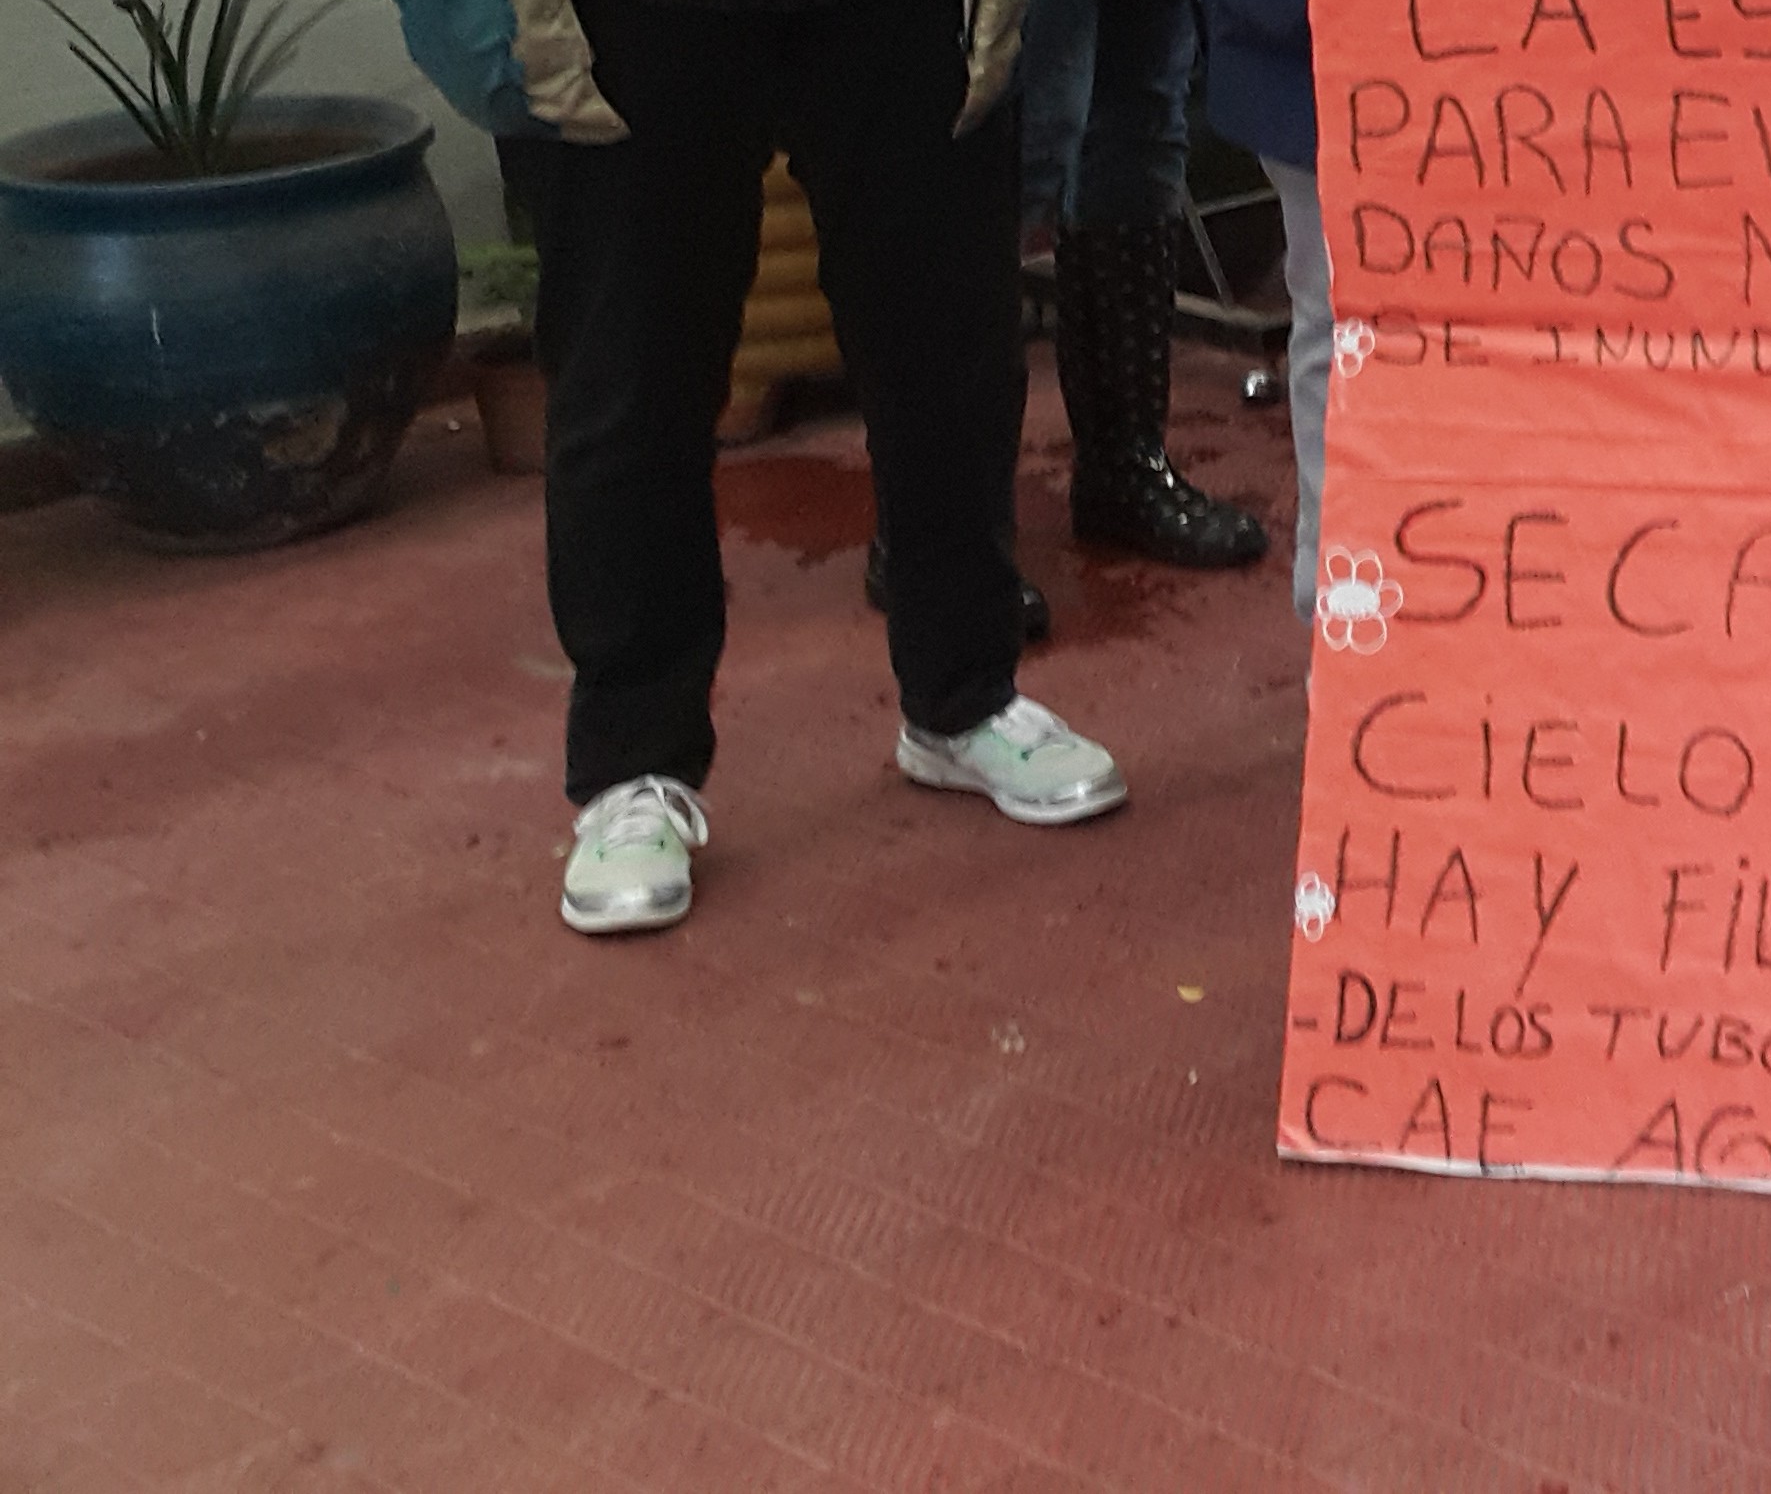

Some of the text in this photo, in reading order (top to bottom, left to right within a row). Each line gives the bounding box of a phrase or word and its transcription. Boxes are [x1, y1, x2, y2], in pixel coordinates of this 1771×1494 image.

[1348, 79, 1634, 194] PARA
[1352, 202, 1677, 302] DAÑOS
[1331, 824, 1580, 997] HAY
[1455, 988, 1554, 1059] LOS
[1304, 1075, 1534, 1178] CAE
